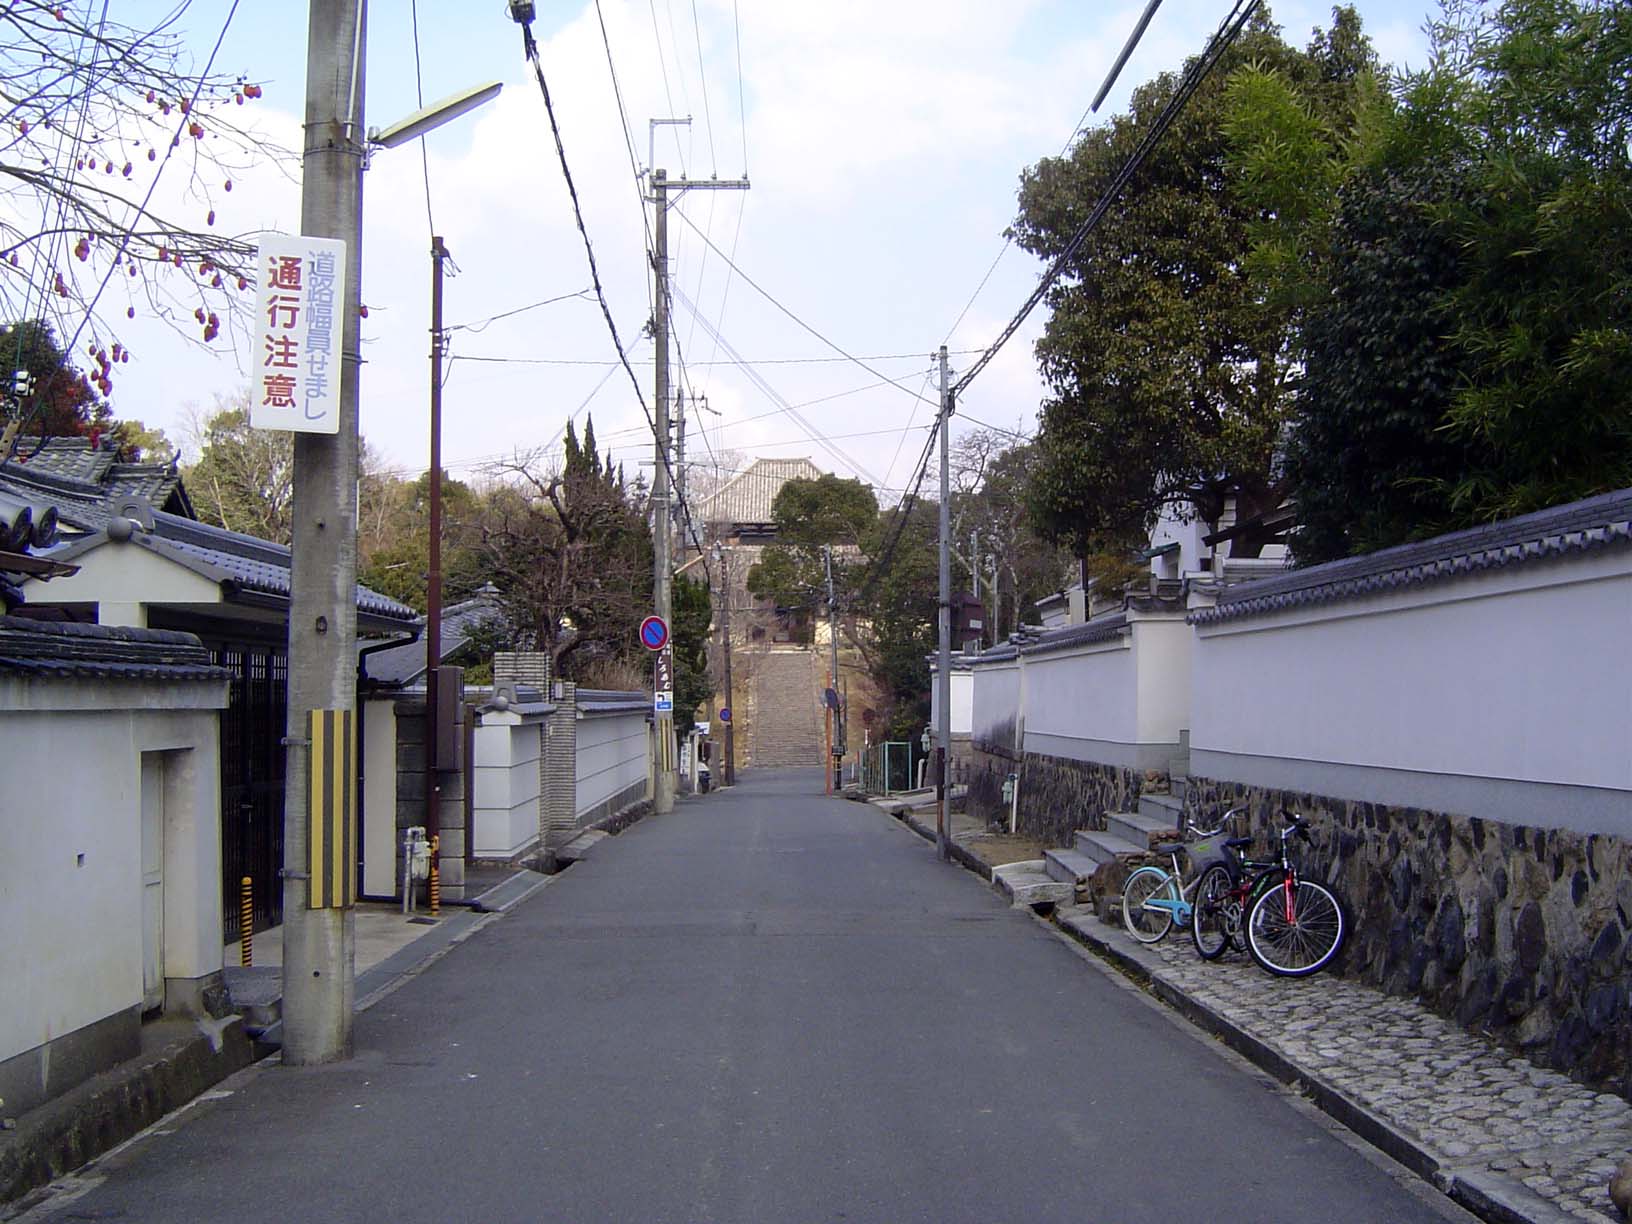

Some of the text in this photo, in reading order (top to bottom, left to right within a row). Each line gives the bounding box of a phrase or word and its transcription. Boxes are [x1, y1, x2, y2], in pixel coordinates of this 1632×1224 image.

[262, 256, 302, 408] 通行注意
[305, 250, 335, 420] 道路幅員せまし
